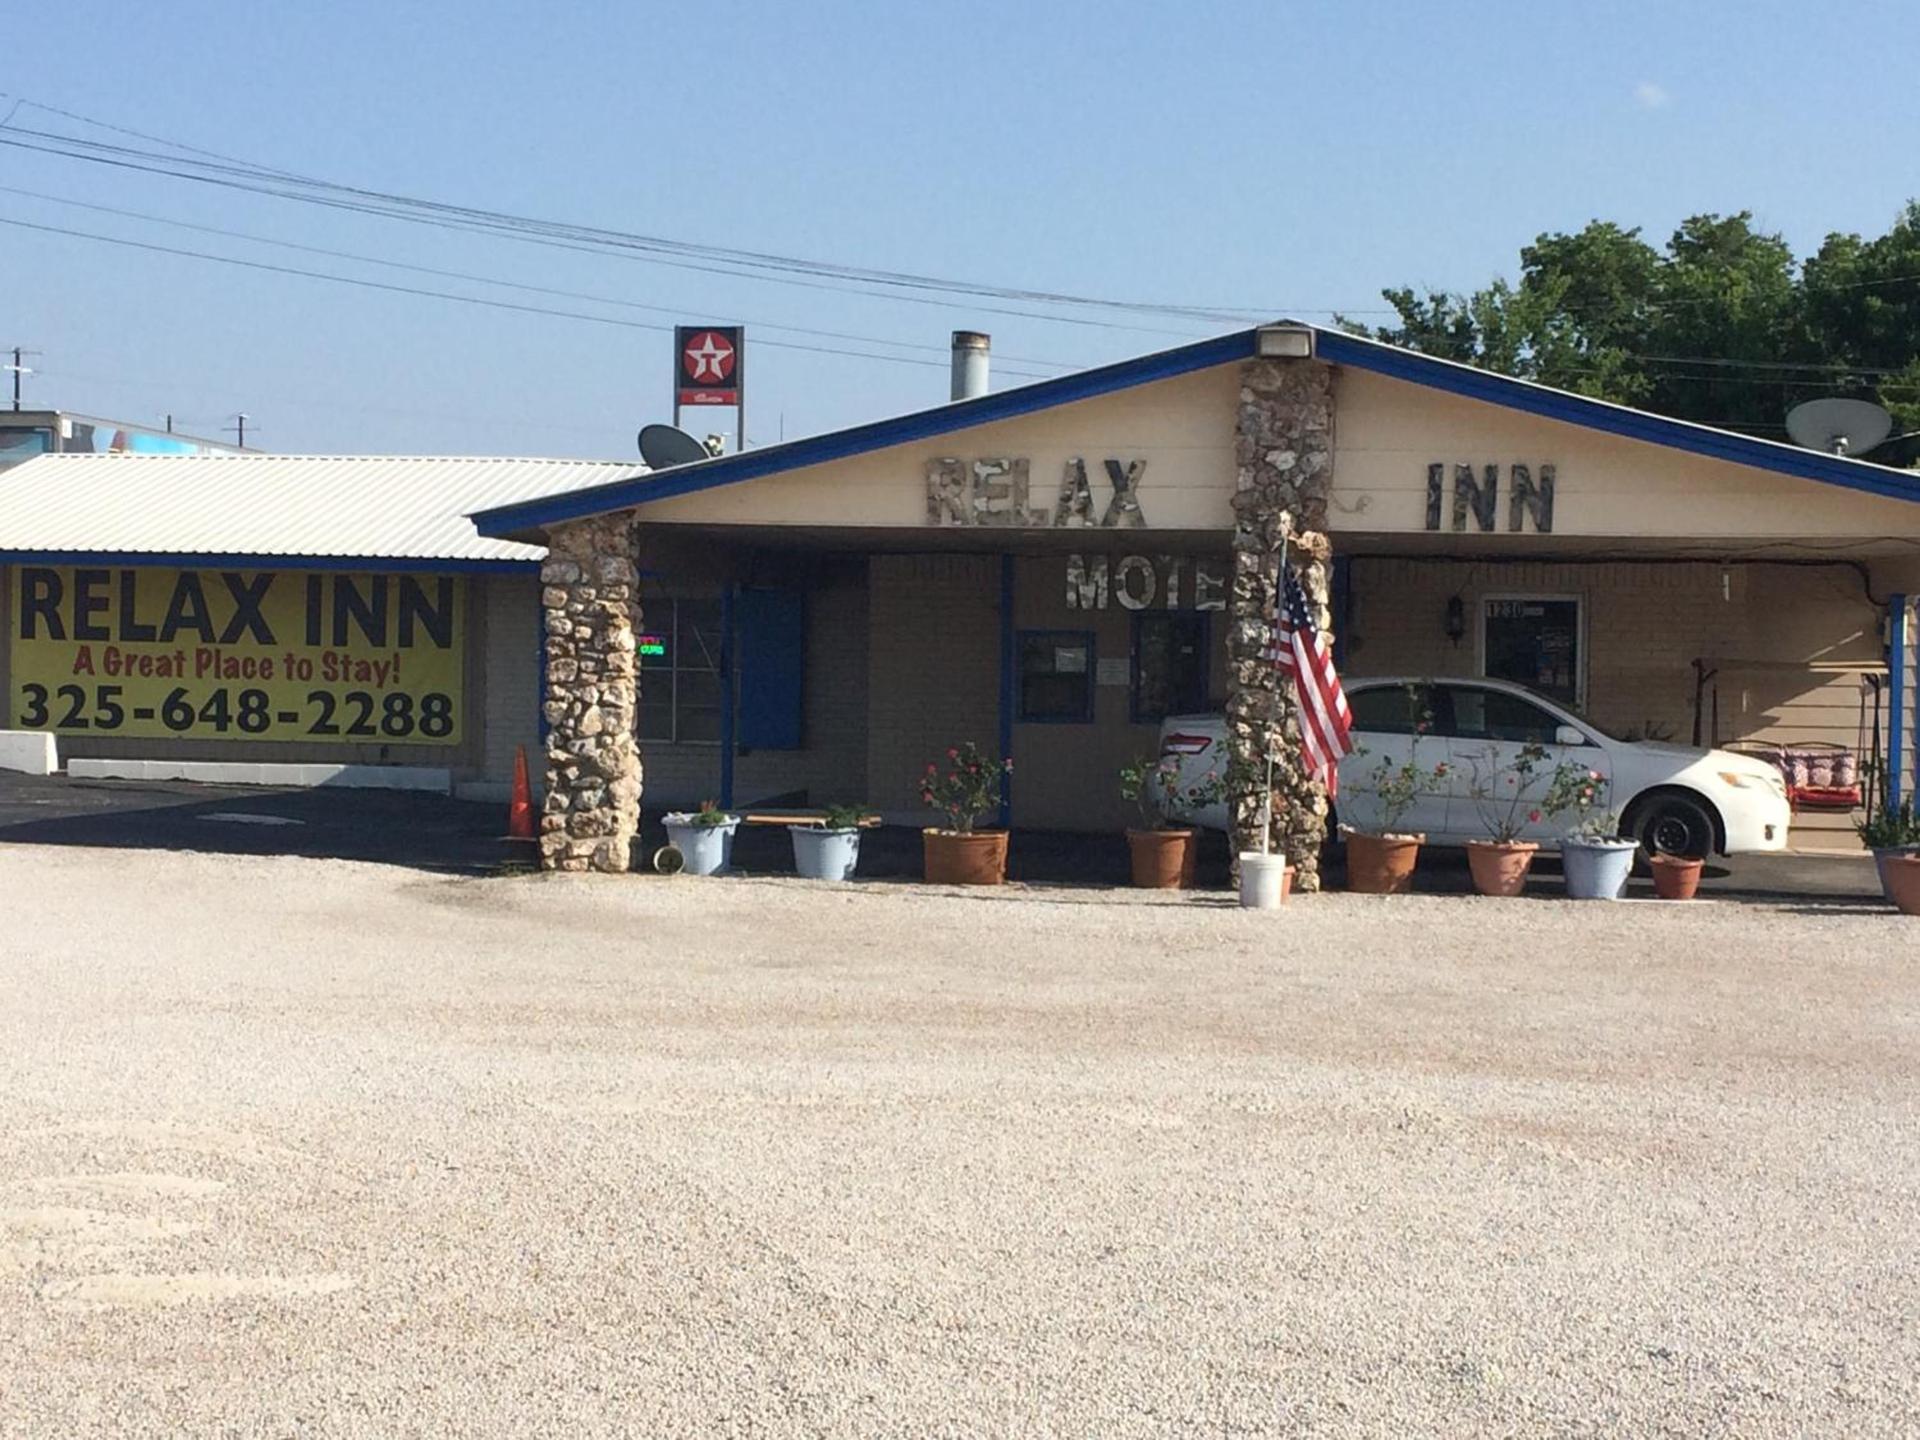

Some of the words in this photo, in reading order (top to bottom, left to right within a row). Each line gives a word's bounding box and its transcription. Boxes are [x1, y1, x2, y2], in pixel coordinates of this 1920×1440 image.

[926, 457, 1147, 528] RELAX
[1426, 463, 1555, 533] INN
[20, 567, 277, 646] RELAX
[306, 574, 454, 649] INN
[1066, 553, 1227, 611] MOTE
[73, 645, 95, 676] A
[103, 646, 186, 679] Great
[195, 648, 274, 681] Place
[283, 652, 313, 681] to
[322, 650, 401, 689] Stay!
[20, 683, 454, 738] 325-648-2288
